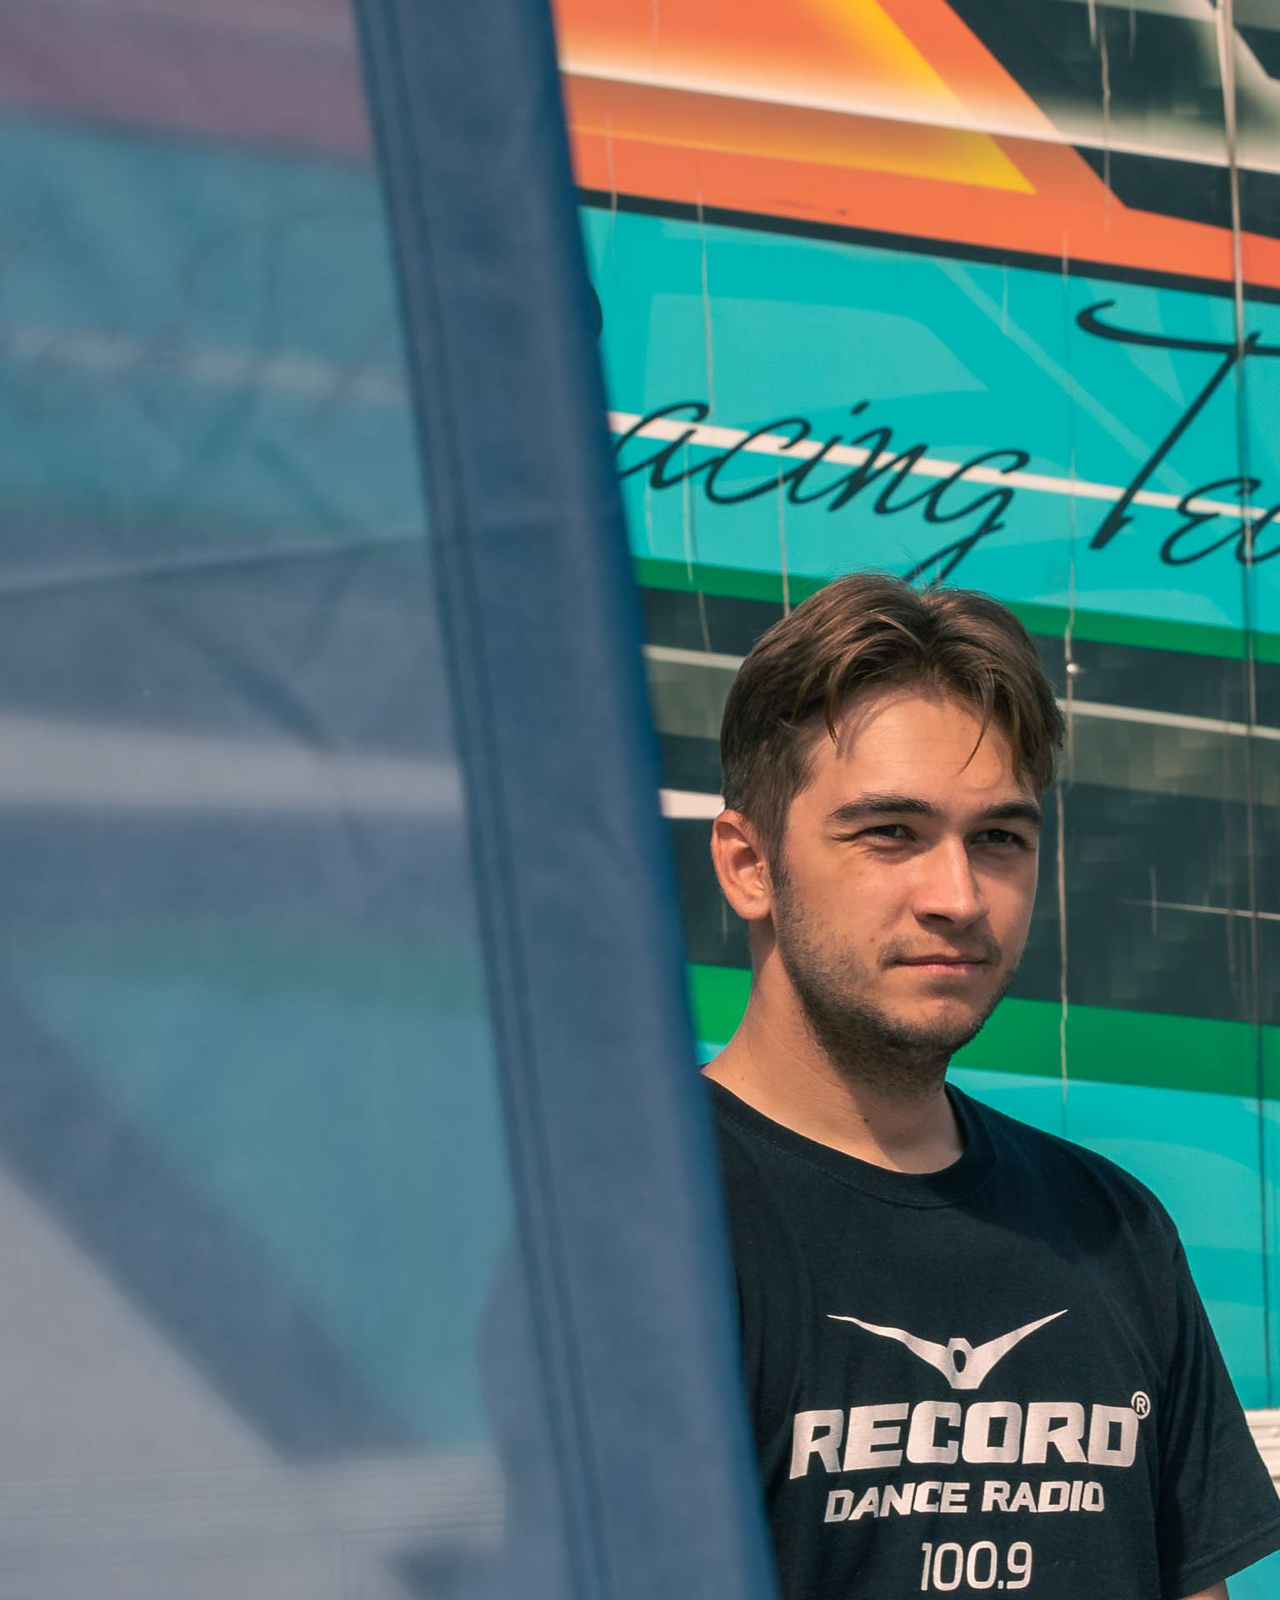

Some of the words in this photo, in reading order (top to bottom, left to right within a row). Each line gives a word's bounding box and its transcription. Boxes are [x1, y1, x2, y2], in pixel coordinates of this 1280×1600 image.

[612, 401, 1030, 586] acing
[823, 1481, 970, 1523] DANCE
[981, 1480, 1105, 1513] RADIO
[920, 1540, 1033, 1591] 100.9
